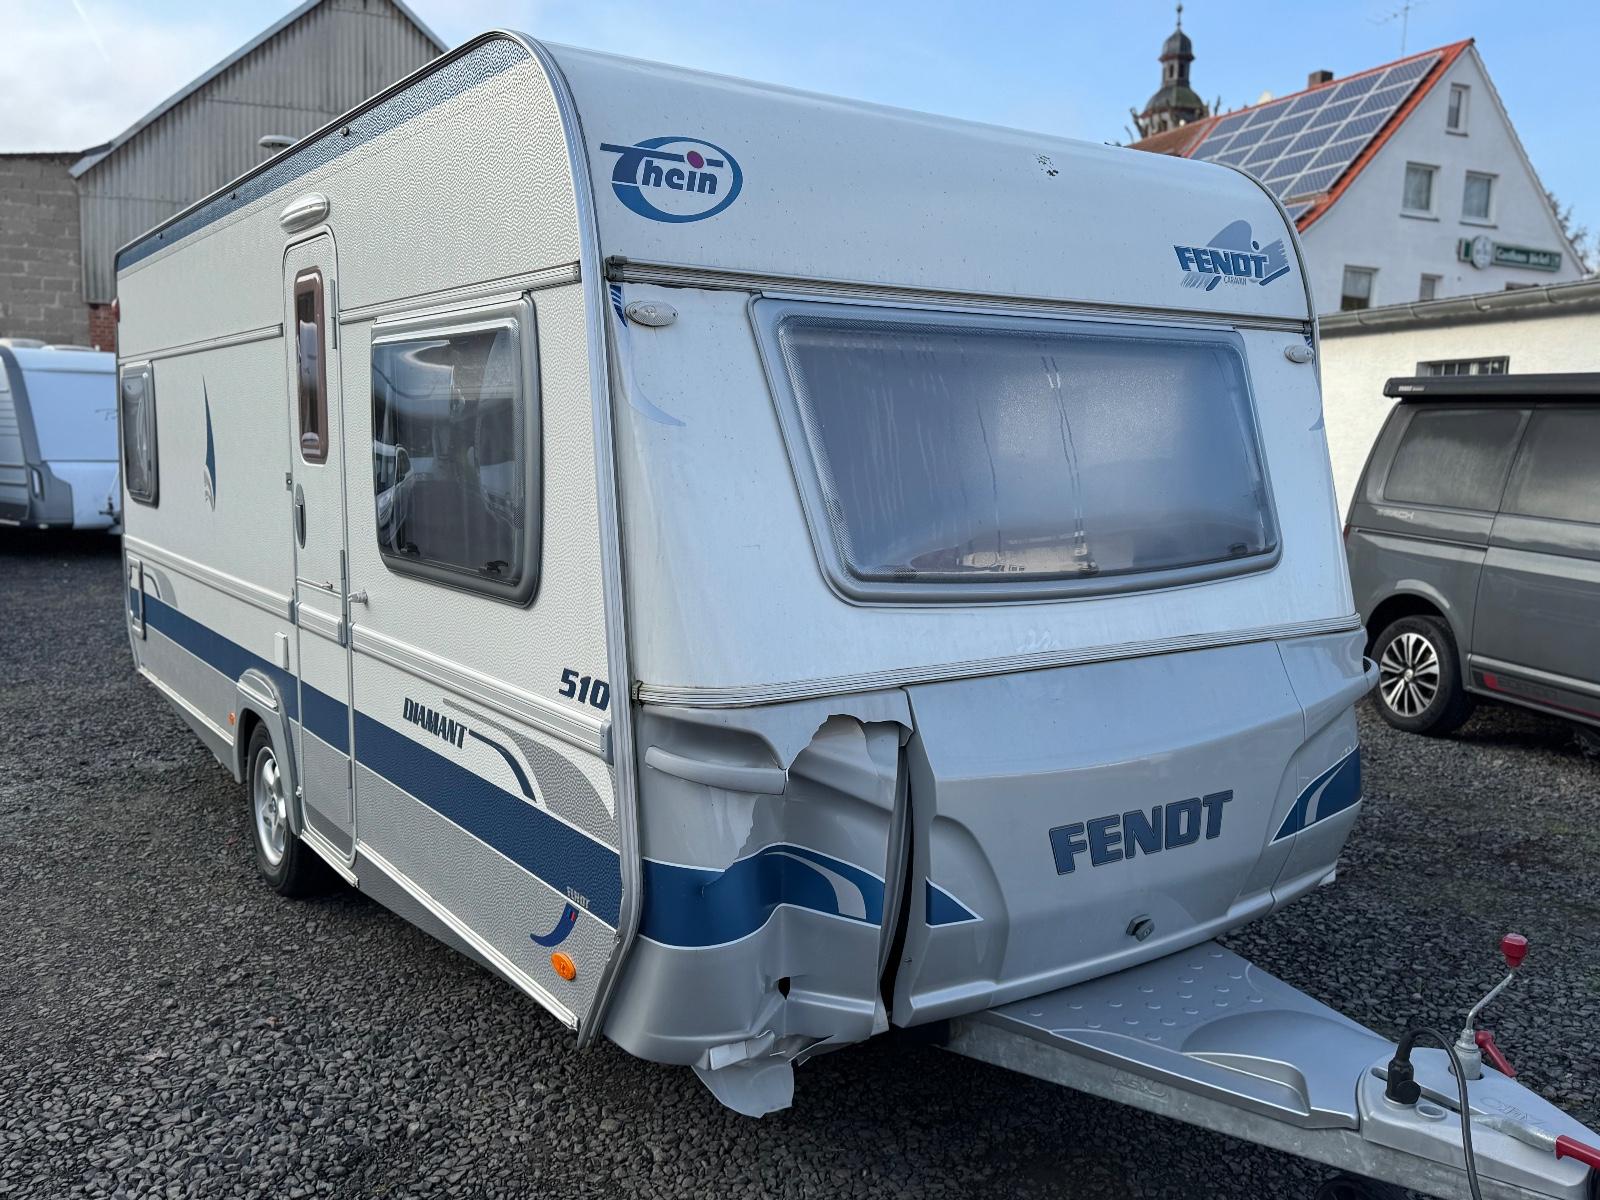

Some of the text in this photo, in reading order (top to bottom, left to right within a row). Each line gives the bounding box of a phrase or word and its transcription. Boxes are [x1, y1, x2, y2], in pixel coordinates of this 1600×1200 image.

[1173, 245, 1267, 279] FENDT
[558, 667, 610, 712] 510
[402, 697, 467, 749] DIAMANT
[1048, 789, 1234, 876] FENDT
